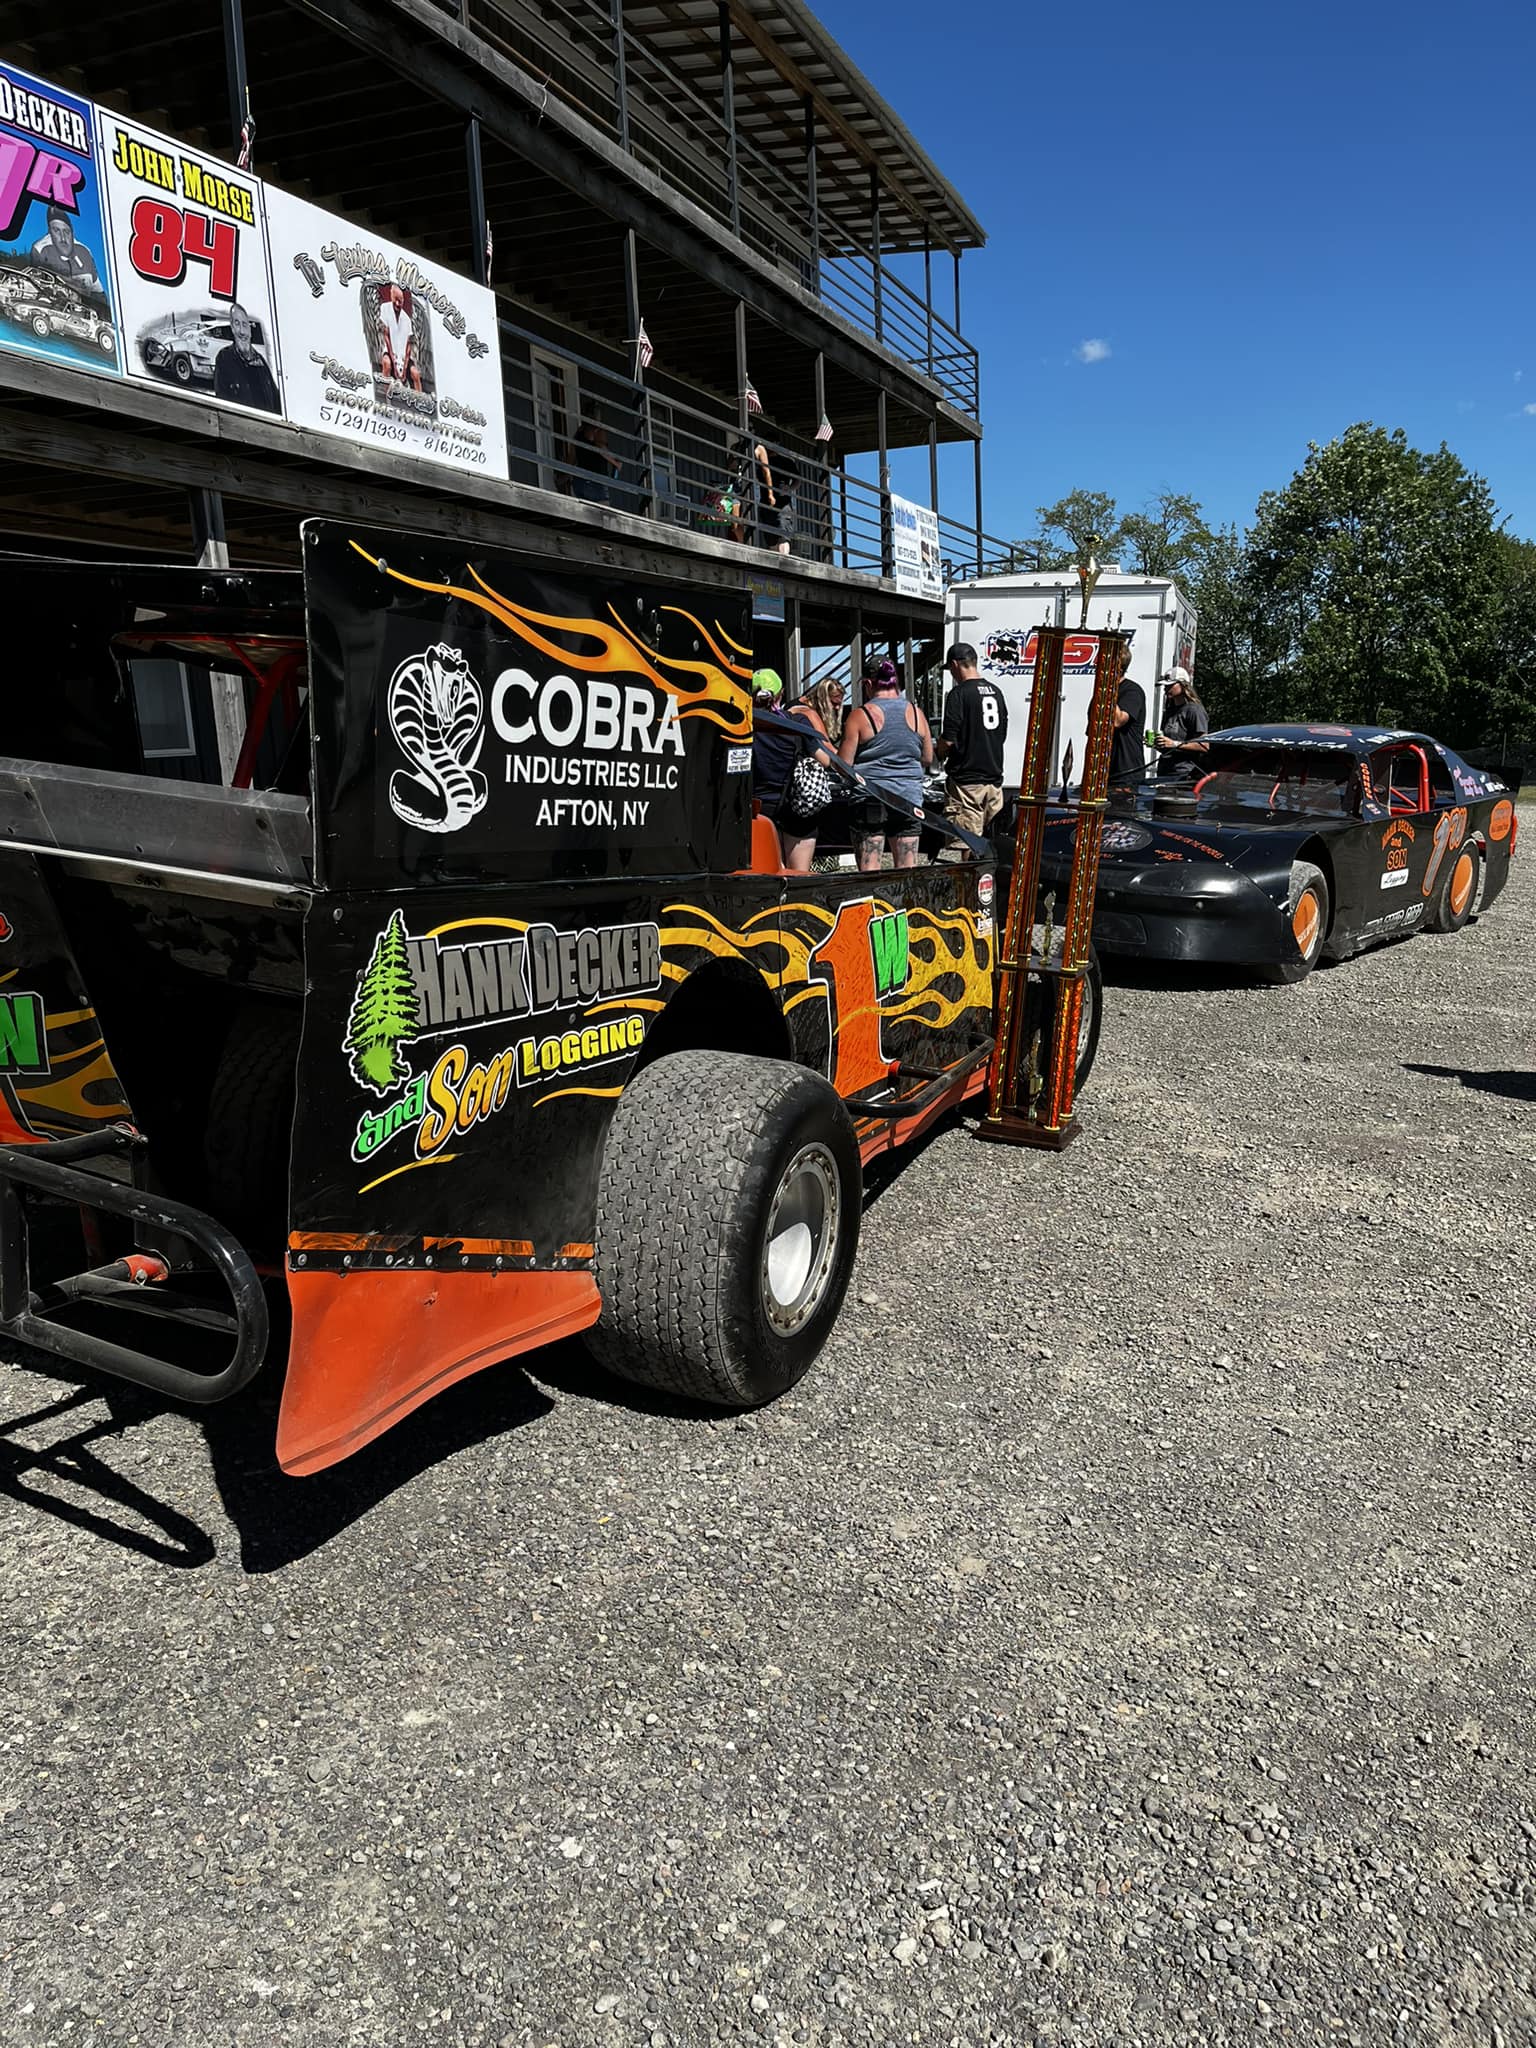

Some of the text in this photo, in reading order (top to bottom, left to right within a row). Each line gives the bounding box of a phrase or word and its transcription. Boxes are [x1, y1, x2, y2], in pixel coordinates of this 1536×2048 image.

[0, 77, 88, 151] DECKER
[114, 129, 255, 227] JOHN MORSE
[129, 197, 238, 298] 84
[294, 253, 325, 298] In
[396, 257, 466, 339] Memory
[319, 405, 407, 442] 5/29/1939
[424, 436, 487, 464] 8/6/2020
[325, 387, 482, 446] SHOW ME YOUR PIT PASS
[491, 668, 686, 756] COBRA
[982, 696, 1000, 730] 8
[505, 754, 679, 789] INDUSTRIES LLC
[536, 799, 650, 830] AFTON, NY
[1387, 848, 1409, 871] SON
[404, 924, 660, 1028] HANK DECKER
[354, 1018, 645, 1160] and Son LOGGING
